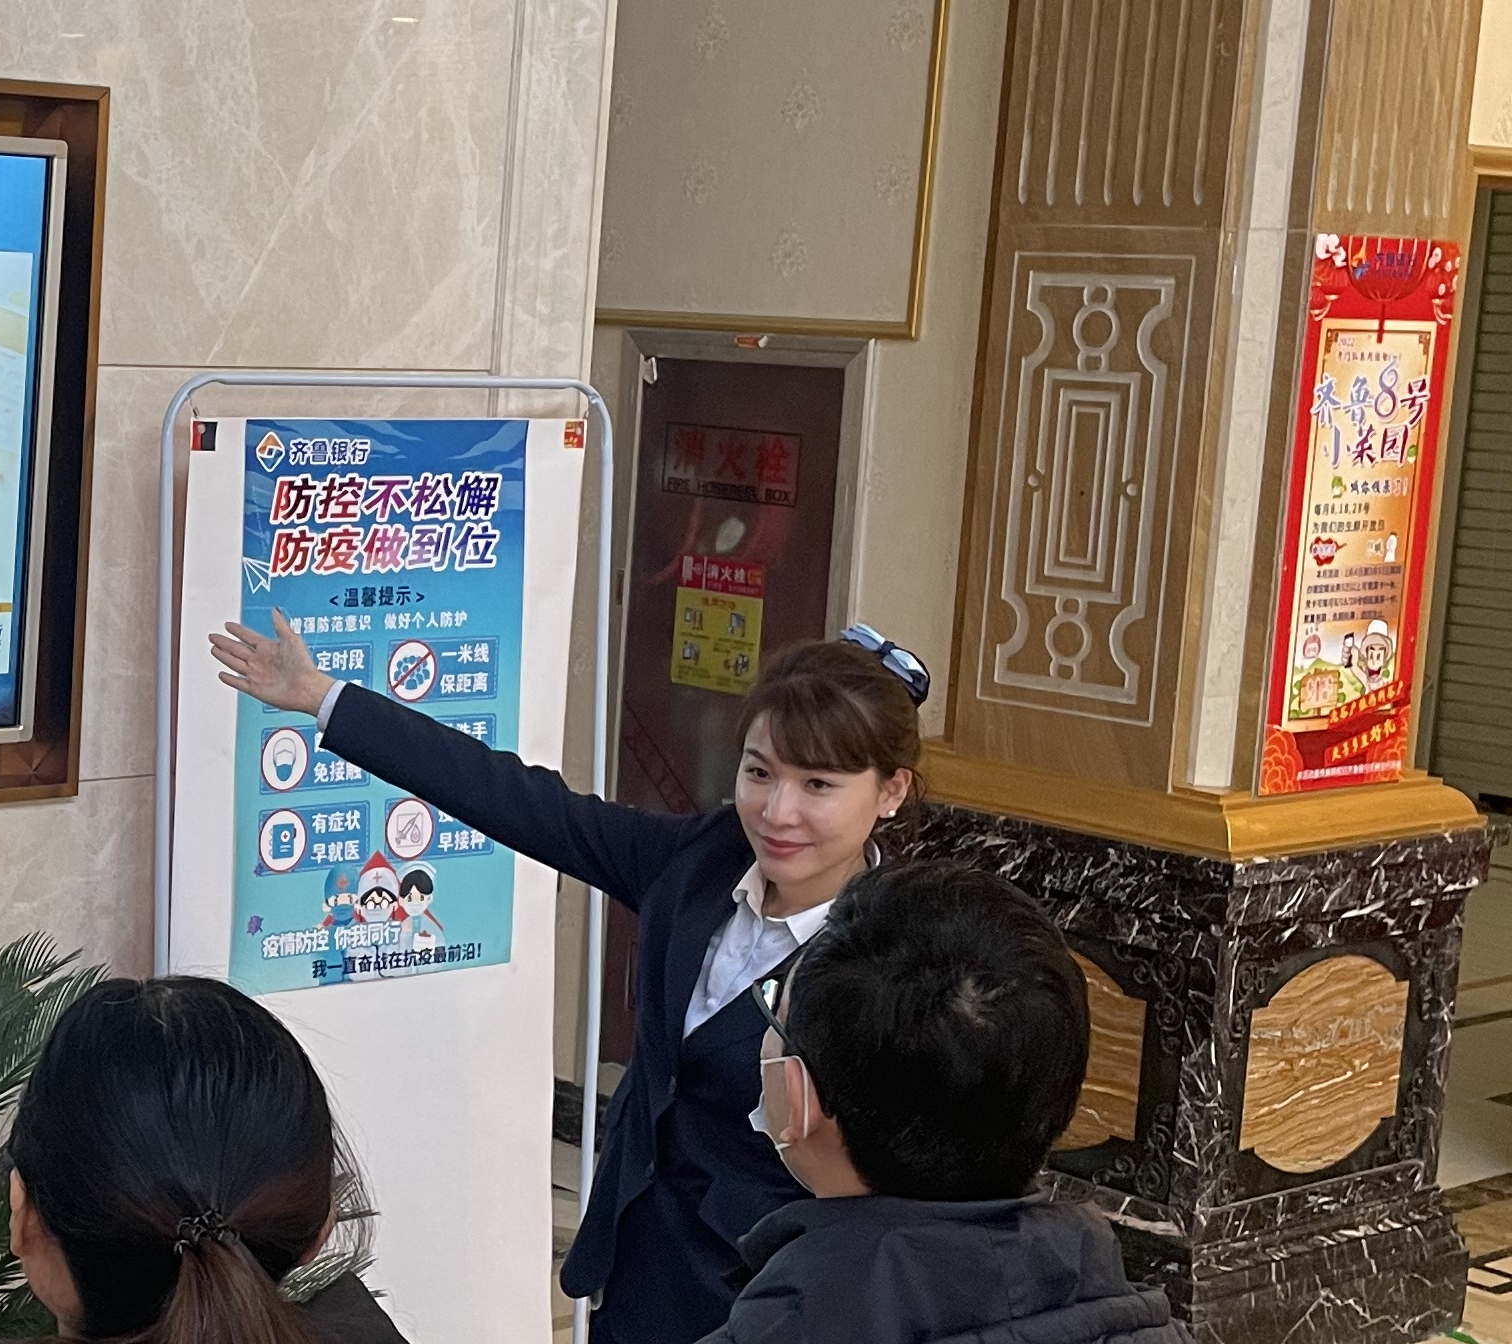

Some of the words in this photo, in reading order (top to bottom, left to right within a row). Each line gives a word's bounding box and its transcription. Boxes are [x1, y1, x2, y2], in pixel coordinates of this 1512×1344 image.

[1310, 359, 1430, 428] 齐鲁8号
[289, 438, 370, 466] 齐鲁银行
[1322, 424, 1409, 469] 小菜园
[271, 473, 500, 524] 防控不松懈
[271, 525, 499, 576] 防疫做到位
[290, 615, 372, 635] 增强防范意识
[384, 611, 468, 630] 做好个人防护
[316, 649, 364, 671] 定时段
[440, 642, 489, 665] 一米线
[439, 672, 488, 694] 保距离
[445, 721, 488, 741] 洗手
[311, 810, 361, 834] 有症状
[310, 840, 360, 863] 早就医
[438, 830, 486, 852] 早接种
[261, 927, 330, 959] 疫情防控
[333, 920, 402, 950] 你我同行
